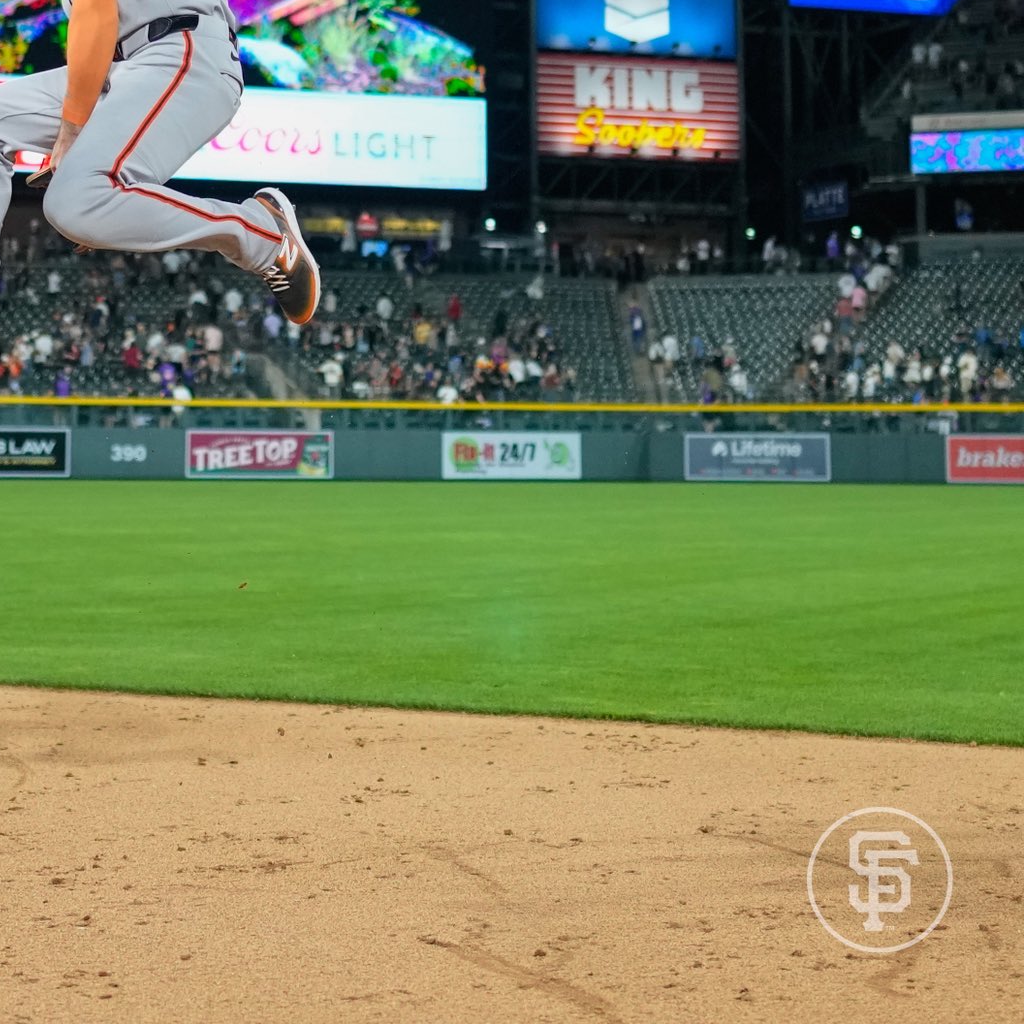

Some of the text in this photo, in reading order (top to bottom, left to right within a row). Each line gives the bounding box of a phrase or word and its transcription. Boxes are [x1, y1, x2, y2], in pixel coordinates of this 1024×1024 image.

[574, 65, 704, 113] KING
[334, 132, 436, 160] LIGHT
[8, 438, 57, 456] LAW
[111, 443, 147, 462] 390
[192, 437, 298, 472] TREE TOP
[730, 439, 803, 458] Lifetime
[957, 445, 1024, 469] brake
